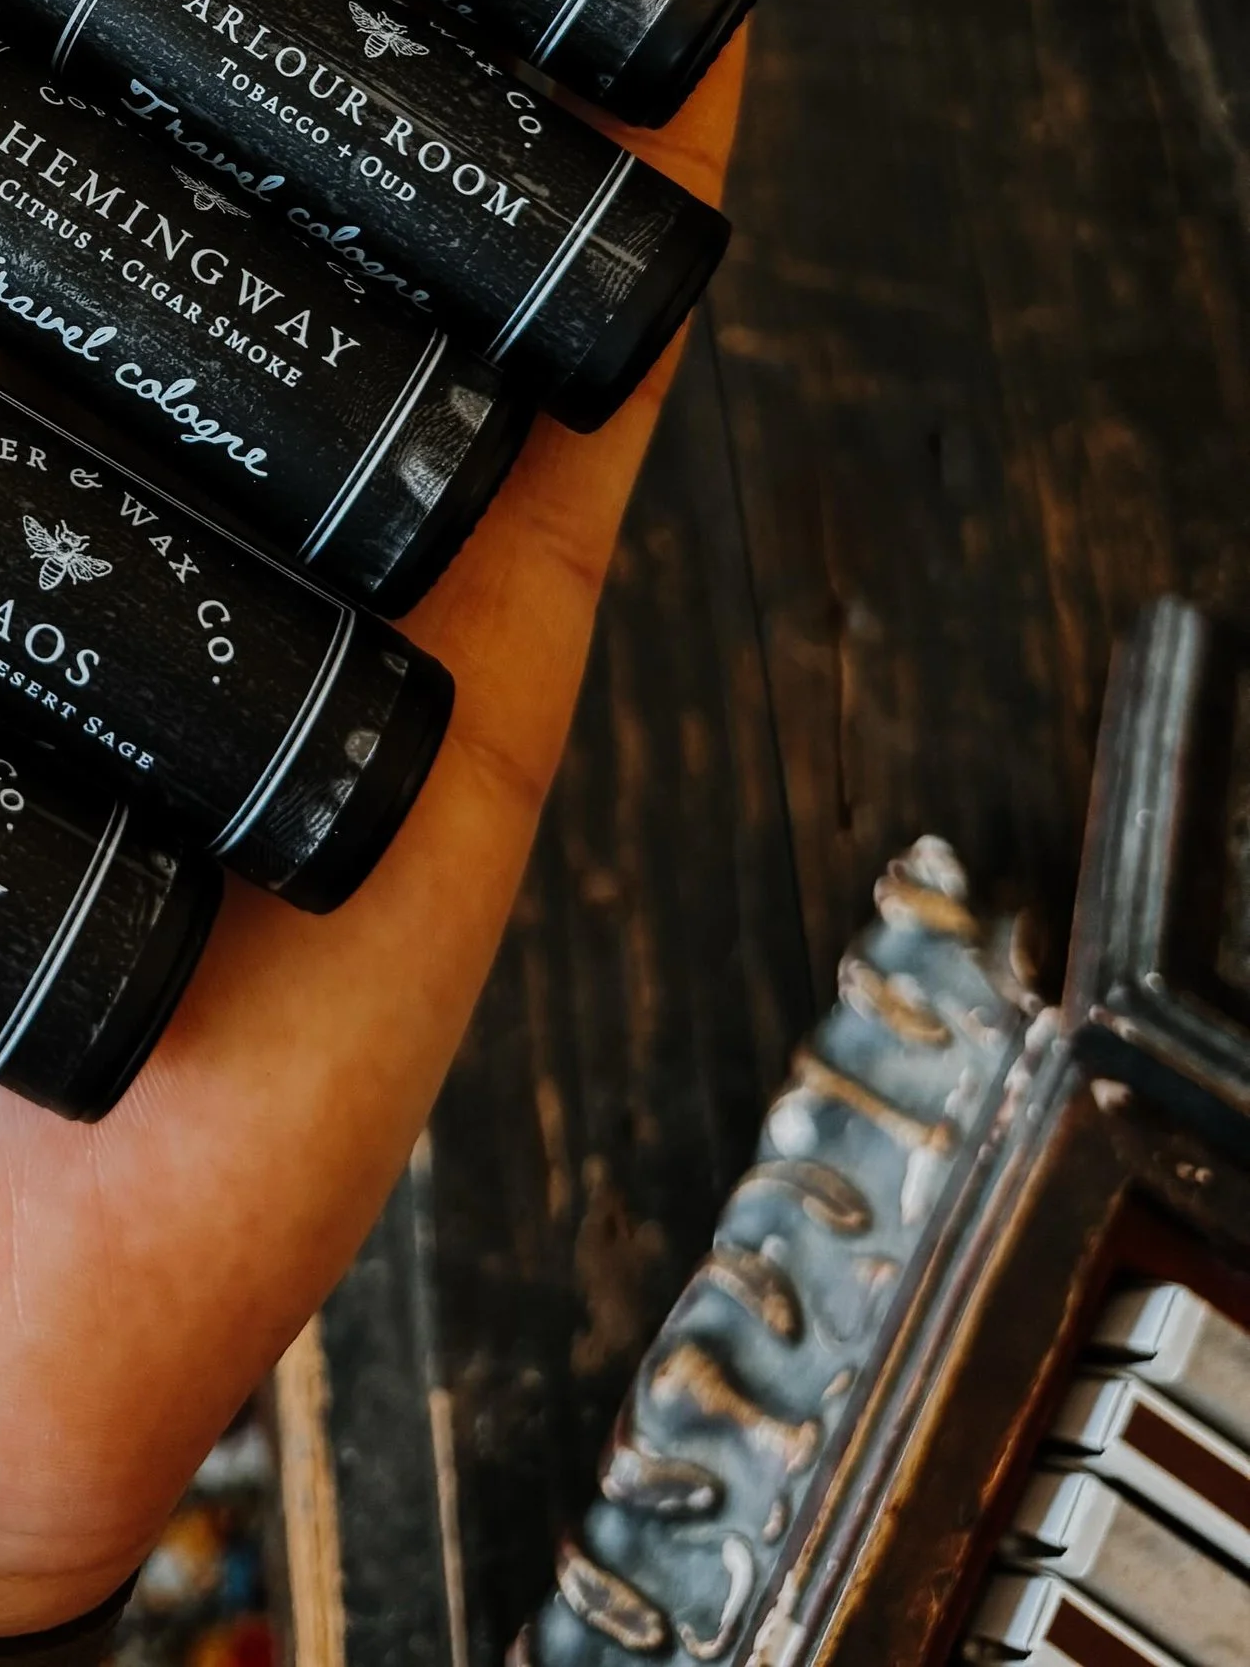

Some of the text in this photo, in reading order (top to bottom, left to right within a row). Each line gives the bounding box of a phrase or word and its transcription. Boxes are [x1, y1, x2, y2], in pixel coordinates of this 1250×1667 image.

[120, 78, 285, 202] Travel
[287, 207, 434, 313] cologne
[216, 56, 330, 144] TOBACCO
[360, 156, 417, 203] OUD
[380, 115, 531, 227] ROOM
[0, 179, 92, 250] CITRUS
[122, 261, 203, 324] CIGAR
[208, 315, 303, 388] SMOKE
[115, 362, 269, 478] cologne
[70, 468, 103, 489] &
[120, 492, 202, 584] WAX
[197, 600, 235, 685] CO.
[83, 716, 155, 771] SAGE
